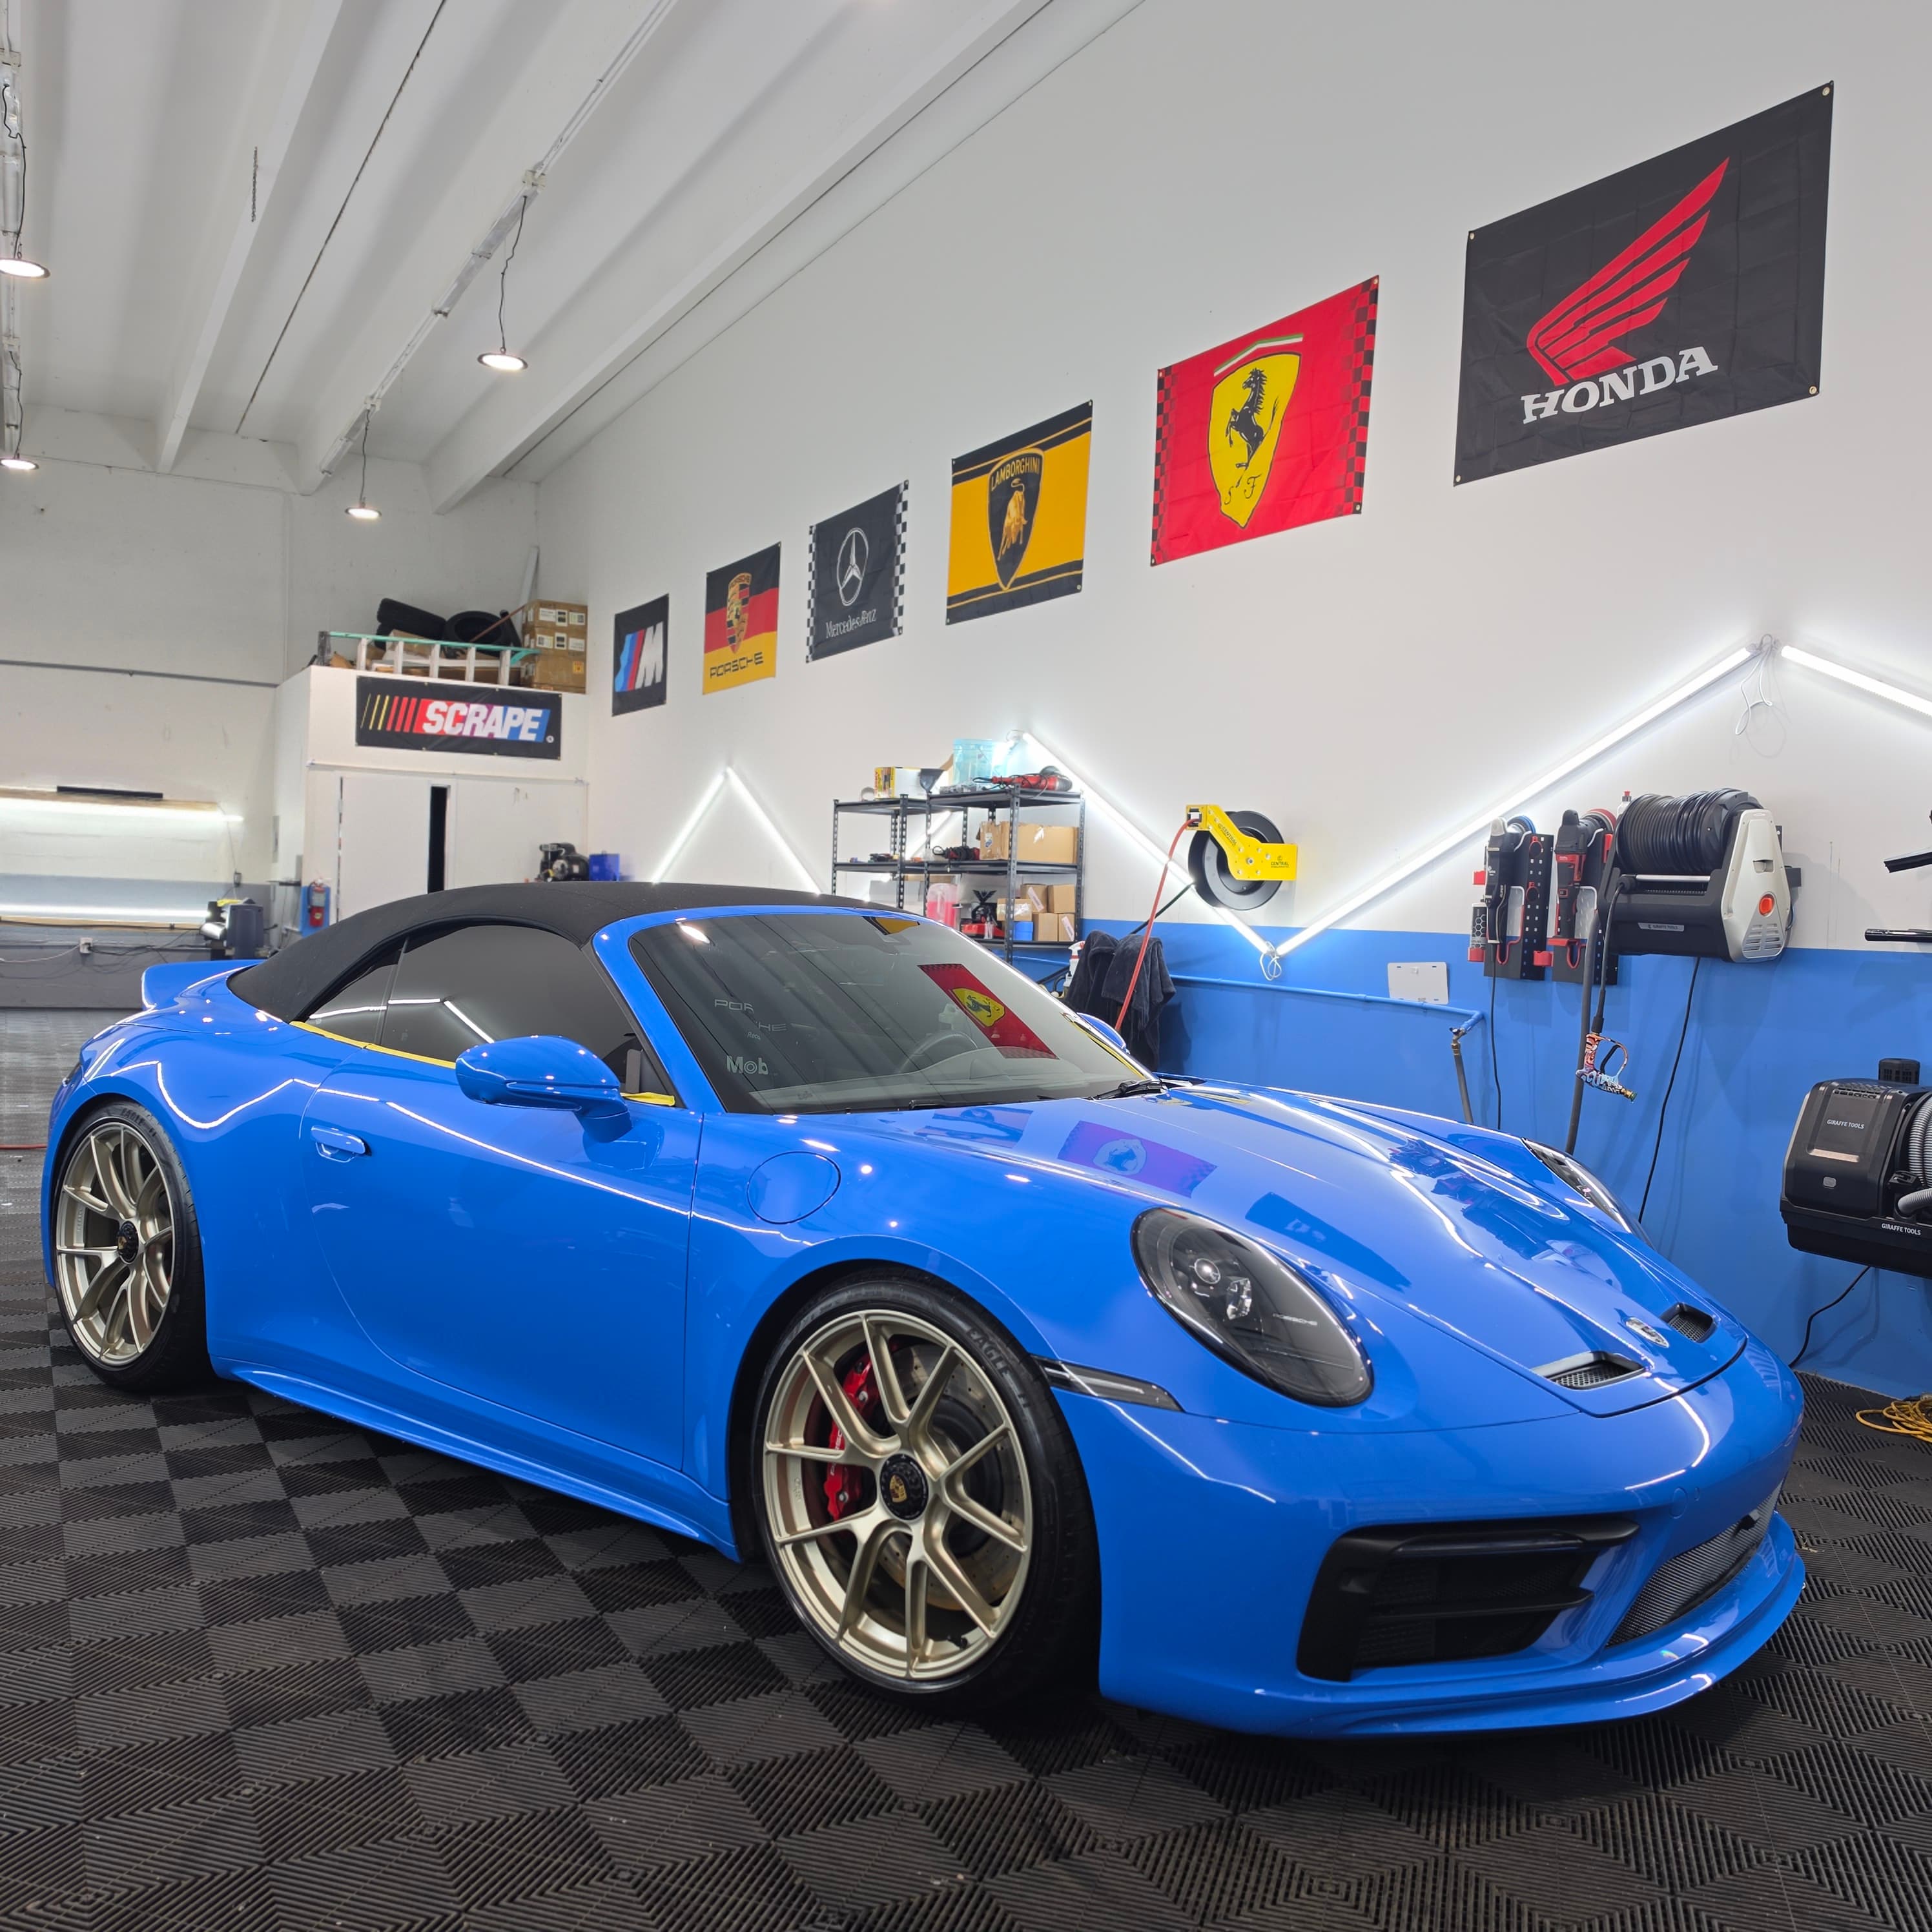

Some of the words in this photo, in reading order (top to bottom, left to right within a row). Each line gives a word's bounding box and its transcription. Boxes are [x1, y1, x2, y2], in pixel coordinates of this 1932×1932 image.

[1521, 346, 1718, 424] HONDA
[991, 456, 1040, 491] LAMBORGHINI
[710, 651, 764, 679] PORSCHE
[422, 701, 544, 741] SCRAPE
[1881, 1223, 1903, 1232] GIRAFFE
[1904, 1227, 1922, 1235] TOOLS
